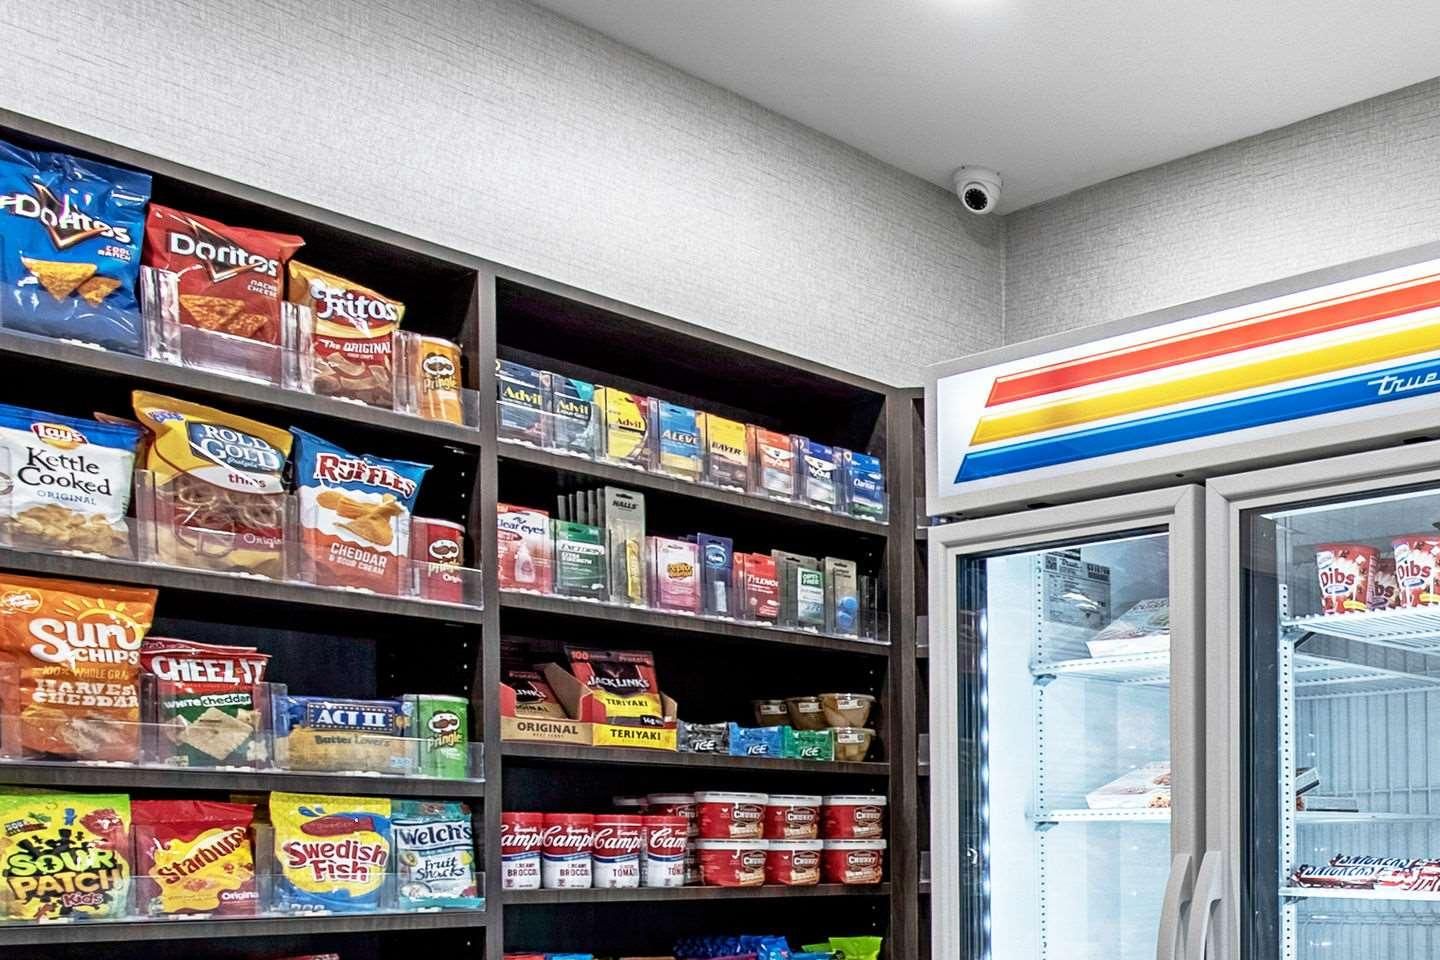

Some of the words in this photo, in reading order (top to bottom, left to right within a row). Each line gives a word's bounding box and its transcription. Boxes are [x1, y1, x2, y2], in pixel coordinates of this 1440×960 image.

[15, 193, 130, 244] Doritos
[170, 232, 279, 277] Doritos
[311, 279, 398, 321] Fritos
[344, 342, 391, 354] ORIGINAL
[503, 386, 543, 405] Advil
[559, 400, 589, 414] Advil
[617, 417, 641, 428] Advil
[203, 424, 270, 450] ROLD
[201, 438, 281, 471] GOLD
[712, 442, 742, 455] BAYER
[26, 447, 100, 475] Kettle
[18, 467, 111, 496] Cooked
[318, 454, 416, 498] RUFFLES
[37, 490, 97, 505] ORIGINAL
[612, 501, 637, 510] HALLS
[521, 521, 545, 534] eyes
[331, 543, 387, 568] CHEDDAR
[1320, 568, 1355, 587] Dibs
[1398, 560, 1432, 579] Dibs
[29, 618, 144, 665] Sun
[77, 649, 139, 665] CHIPS
[202, 693, 252, 707] cheddar
[606, 698, 648, 707] TERIYAKI
[317, 710, 357, 725] ACT
[362, 712, 385, 727] II
[517, 722, 578, 735] ORIGINAL
[610, 729, 661, 740] TERIYAKI
[695, 740, 716, 750] ICE
[748, 745, 768, 754] ICE
[801, 747, 819, 756] ICE
[402, 825, 472, 845] Welch's
[284, 840, 388, 867] Swedish
[9, 850, 115, 875] SOUR
[313, 859, 369, 882] Fish
[424, 857, 459, 870] Fruit
[416, 866, 465, 880] Snacks
[7, 864, 122, 900] PATCH
[62, 893, 104, 908] Kids
